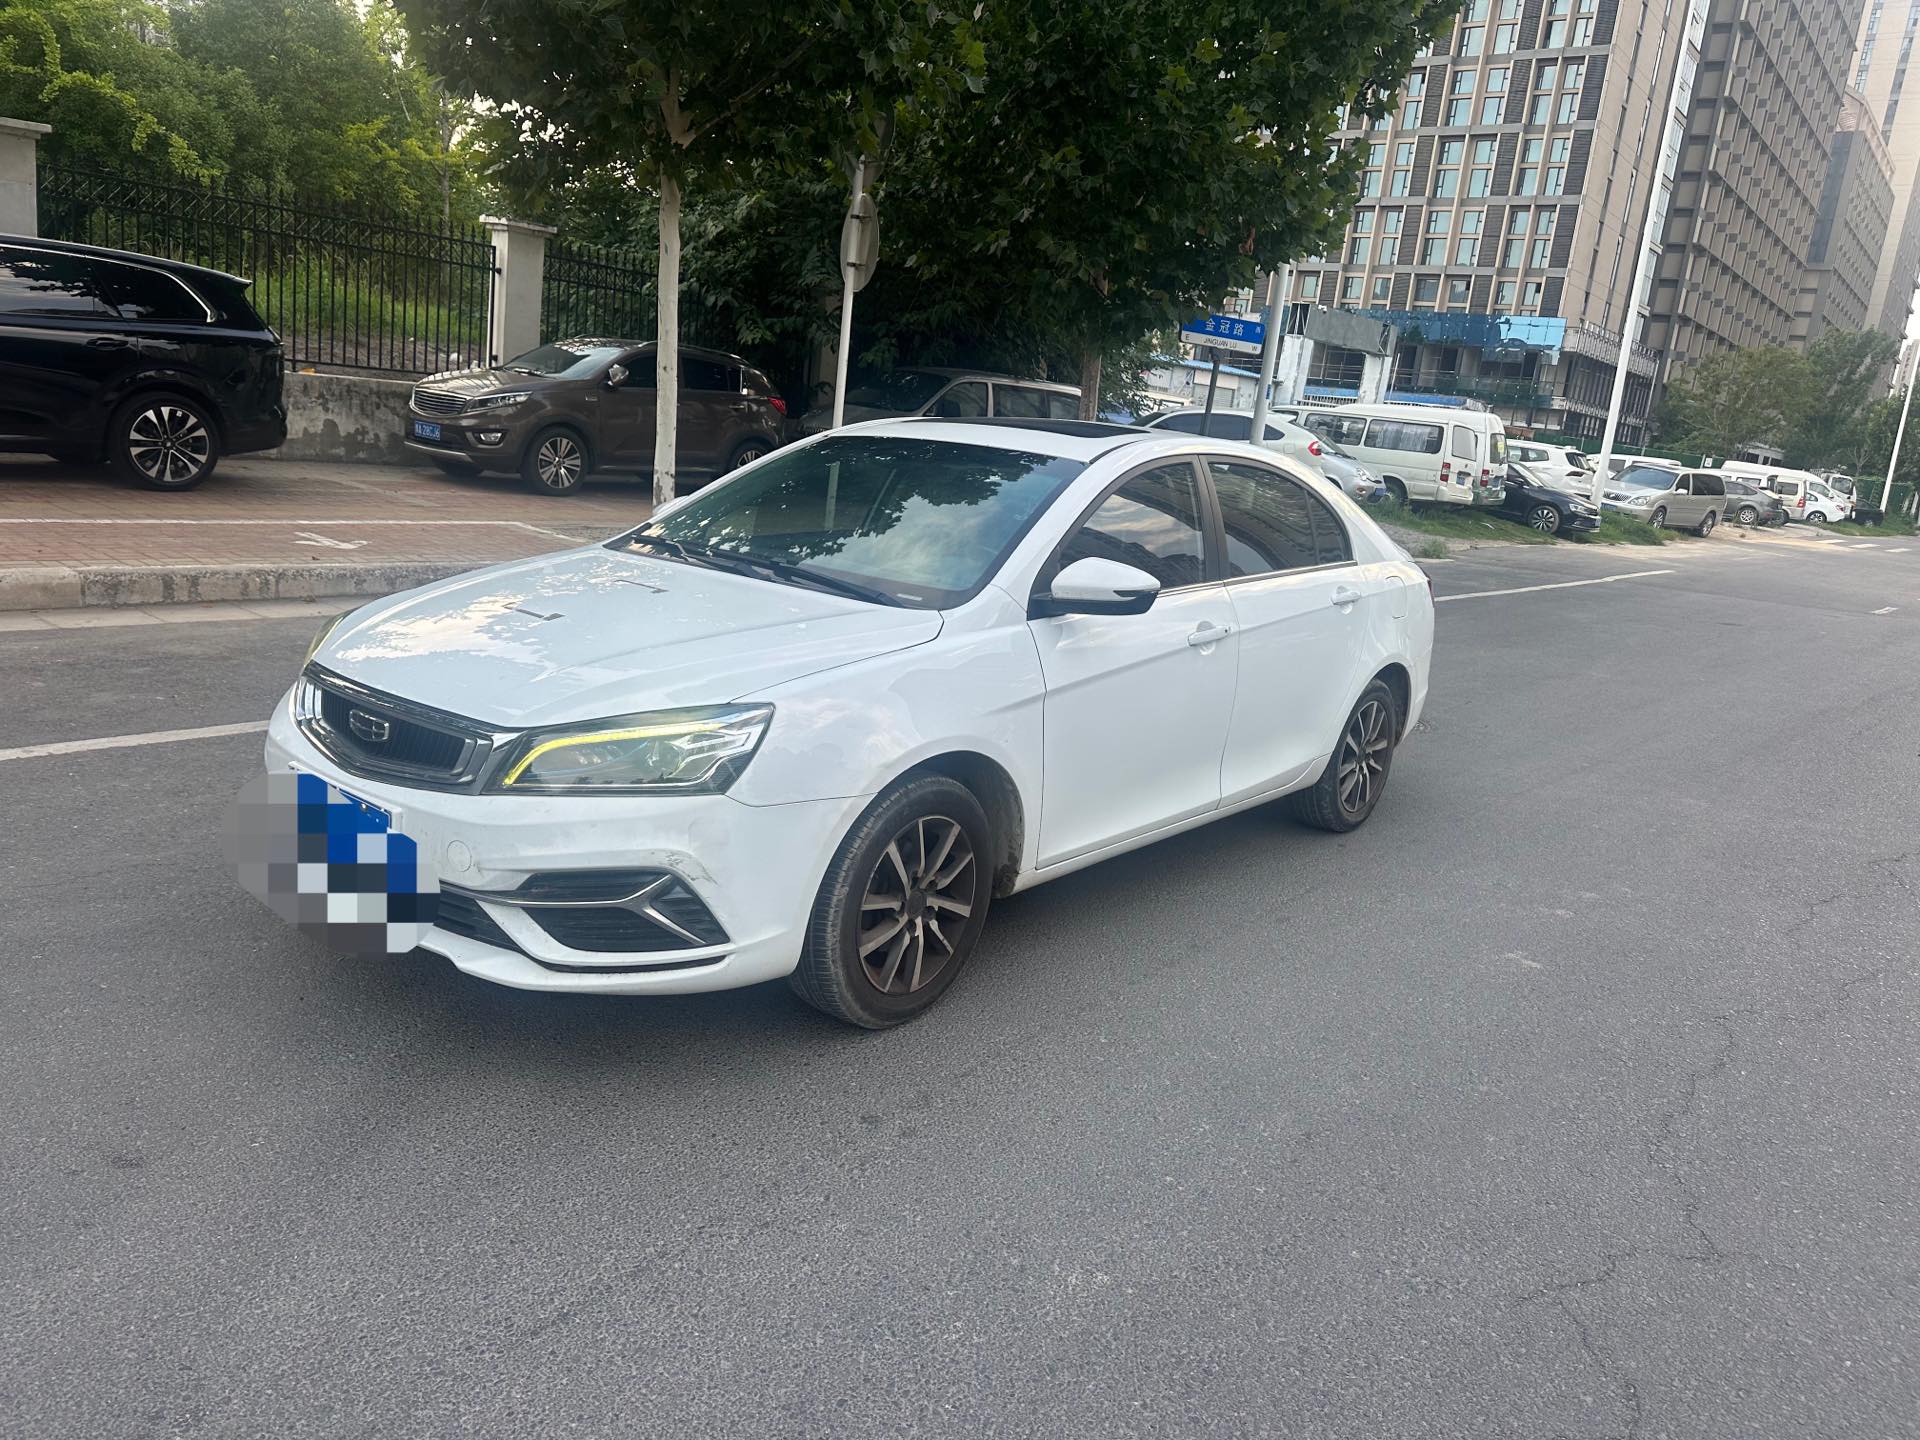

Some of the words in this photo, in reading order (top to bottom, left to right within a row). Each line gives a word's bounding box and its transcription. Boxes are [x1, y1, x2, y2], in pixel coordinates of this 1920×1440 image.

[1205, 318, 1244, 336] 金冠路
[1203, 337, 1228, 347] JINGUAN
